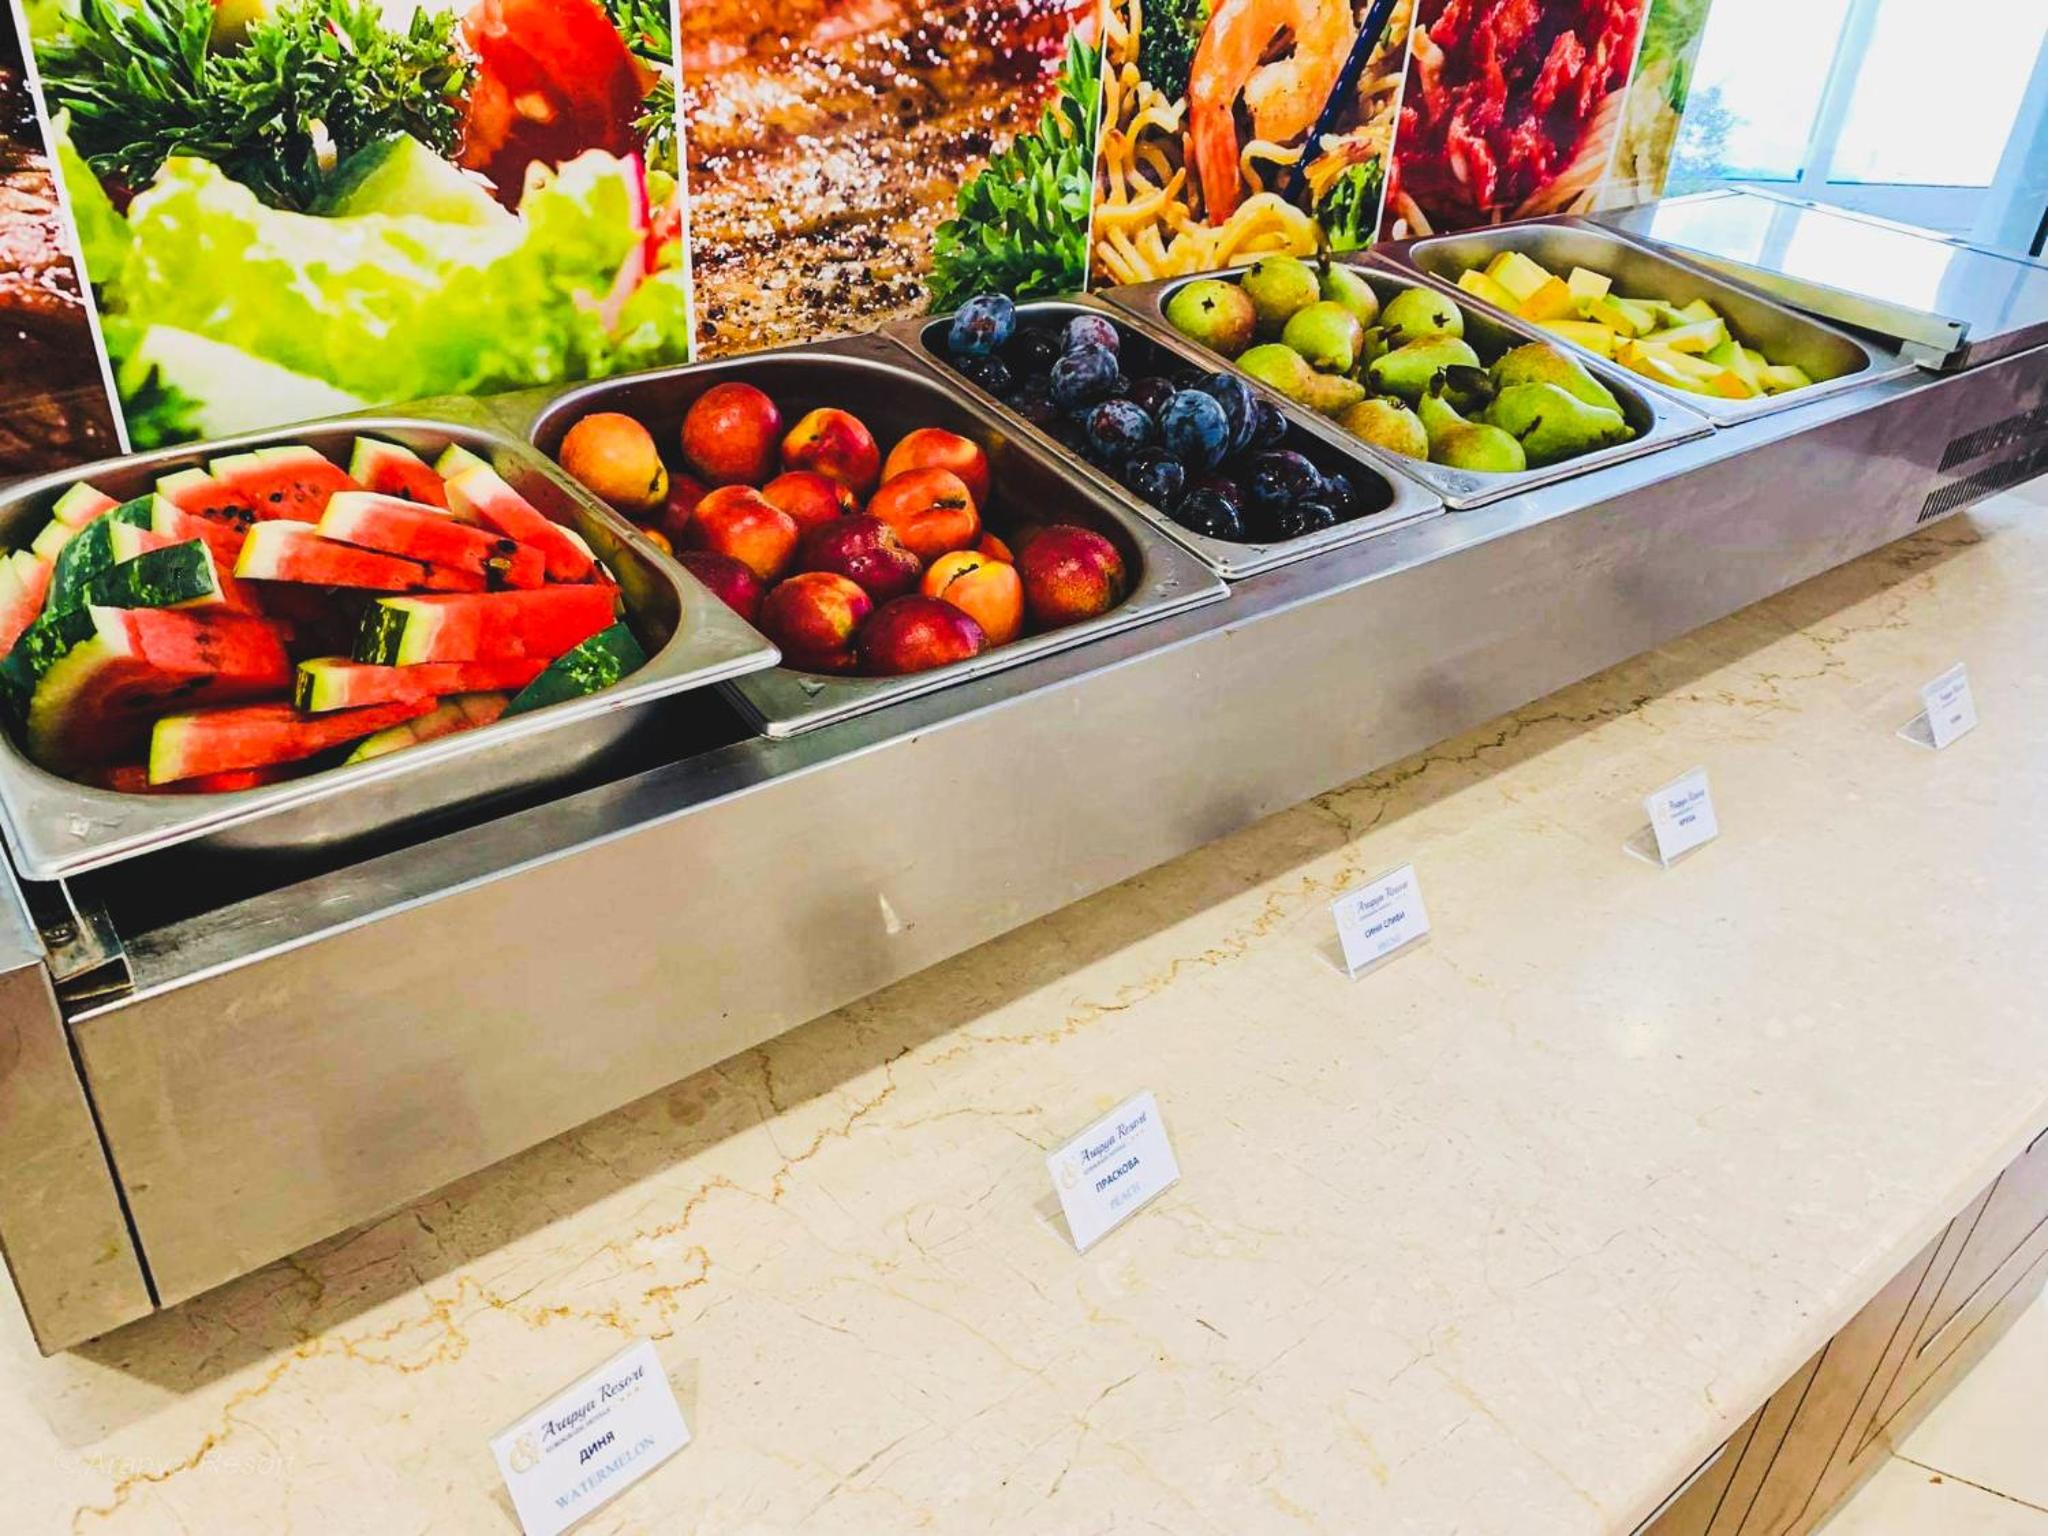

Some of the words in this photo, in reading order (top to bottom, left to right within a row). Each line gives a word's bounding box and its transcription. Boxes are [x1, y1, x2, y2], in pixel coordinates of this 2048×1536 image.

[1095, 1156, 1140, 1193] ПРАСКОВА
[598, 1365, 645, 1403] Resort
[579, 1430, 616, 1465] ДИНЯ
[555, 1434, 656, 1509] WATERMELON
